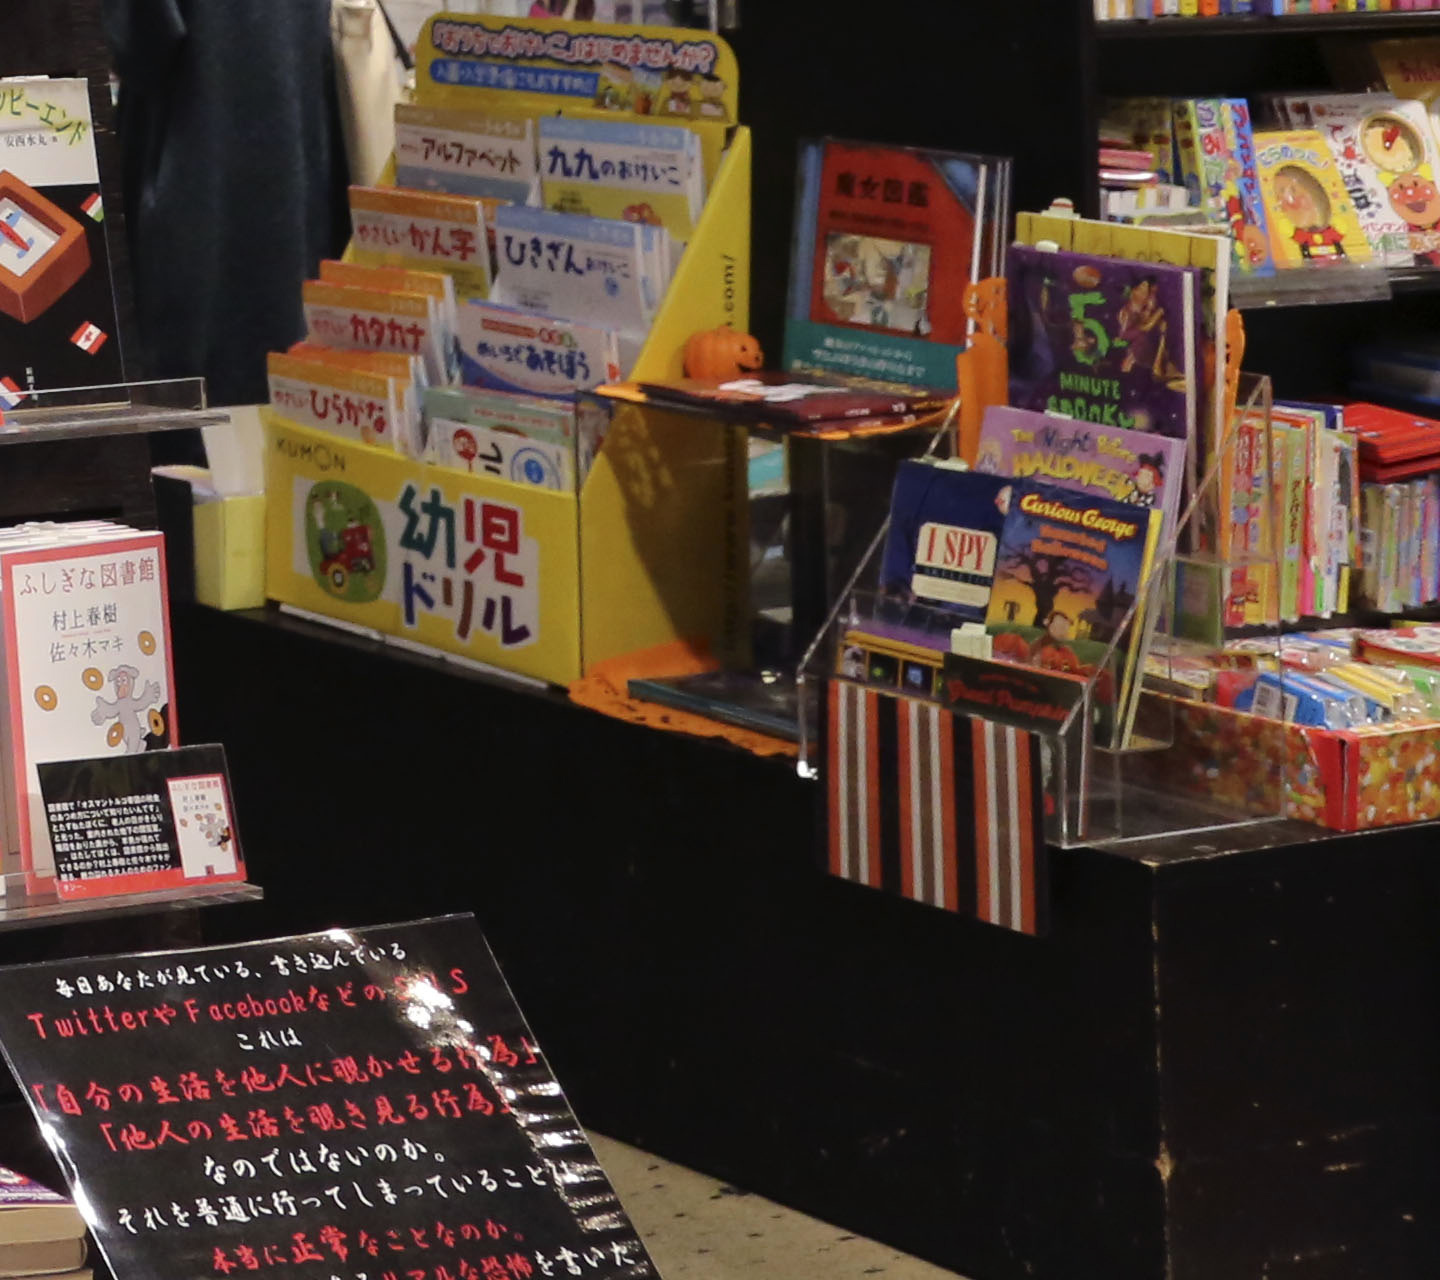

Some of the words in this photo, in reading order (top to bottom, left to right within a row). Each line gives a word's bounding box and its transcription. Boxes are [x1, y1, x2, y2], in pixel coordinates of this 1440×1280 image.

[421, 137, 521, 174] アルファベット
[548, 145, 681, 186] 九九のおけいこ
[408, 223, 476, 261] かん字
[504, 235, 584, 276] ひきざん
[350, 314, 426, 351] カタカナ
[1059, 371, 1121, 399] MINUTE
[309, 388, 388, 434] ひらがな
[277, 439, 347, 472] KUMON
[398, 483, 524, 587] 幼児
[1020, 492, 1081, 523] Curious
[1081, 508, 1137, 540] George
[926, 527, 936, 563] I
[943, 532, 989, 571] SPY
[19, 556, 155, 597] ふしぎな図書館
[51, 602, 118, 632] 村上春樹
[402, 561, 531, 646] ドリル
[236, 1027, 303, 1052] これは
[202, 1138, 448, 1184] なのではないのか。
[116, 1161, 578, 1235] それを普通に行ってしまっていることは
[211, 1218, 526, 1274] 本当に正常なことなのか。
